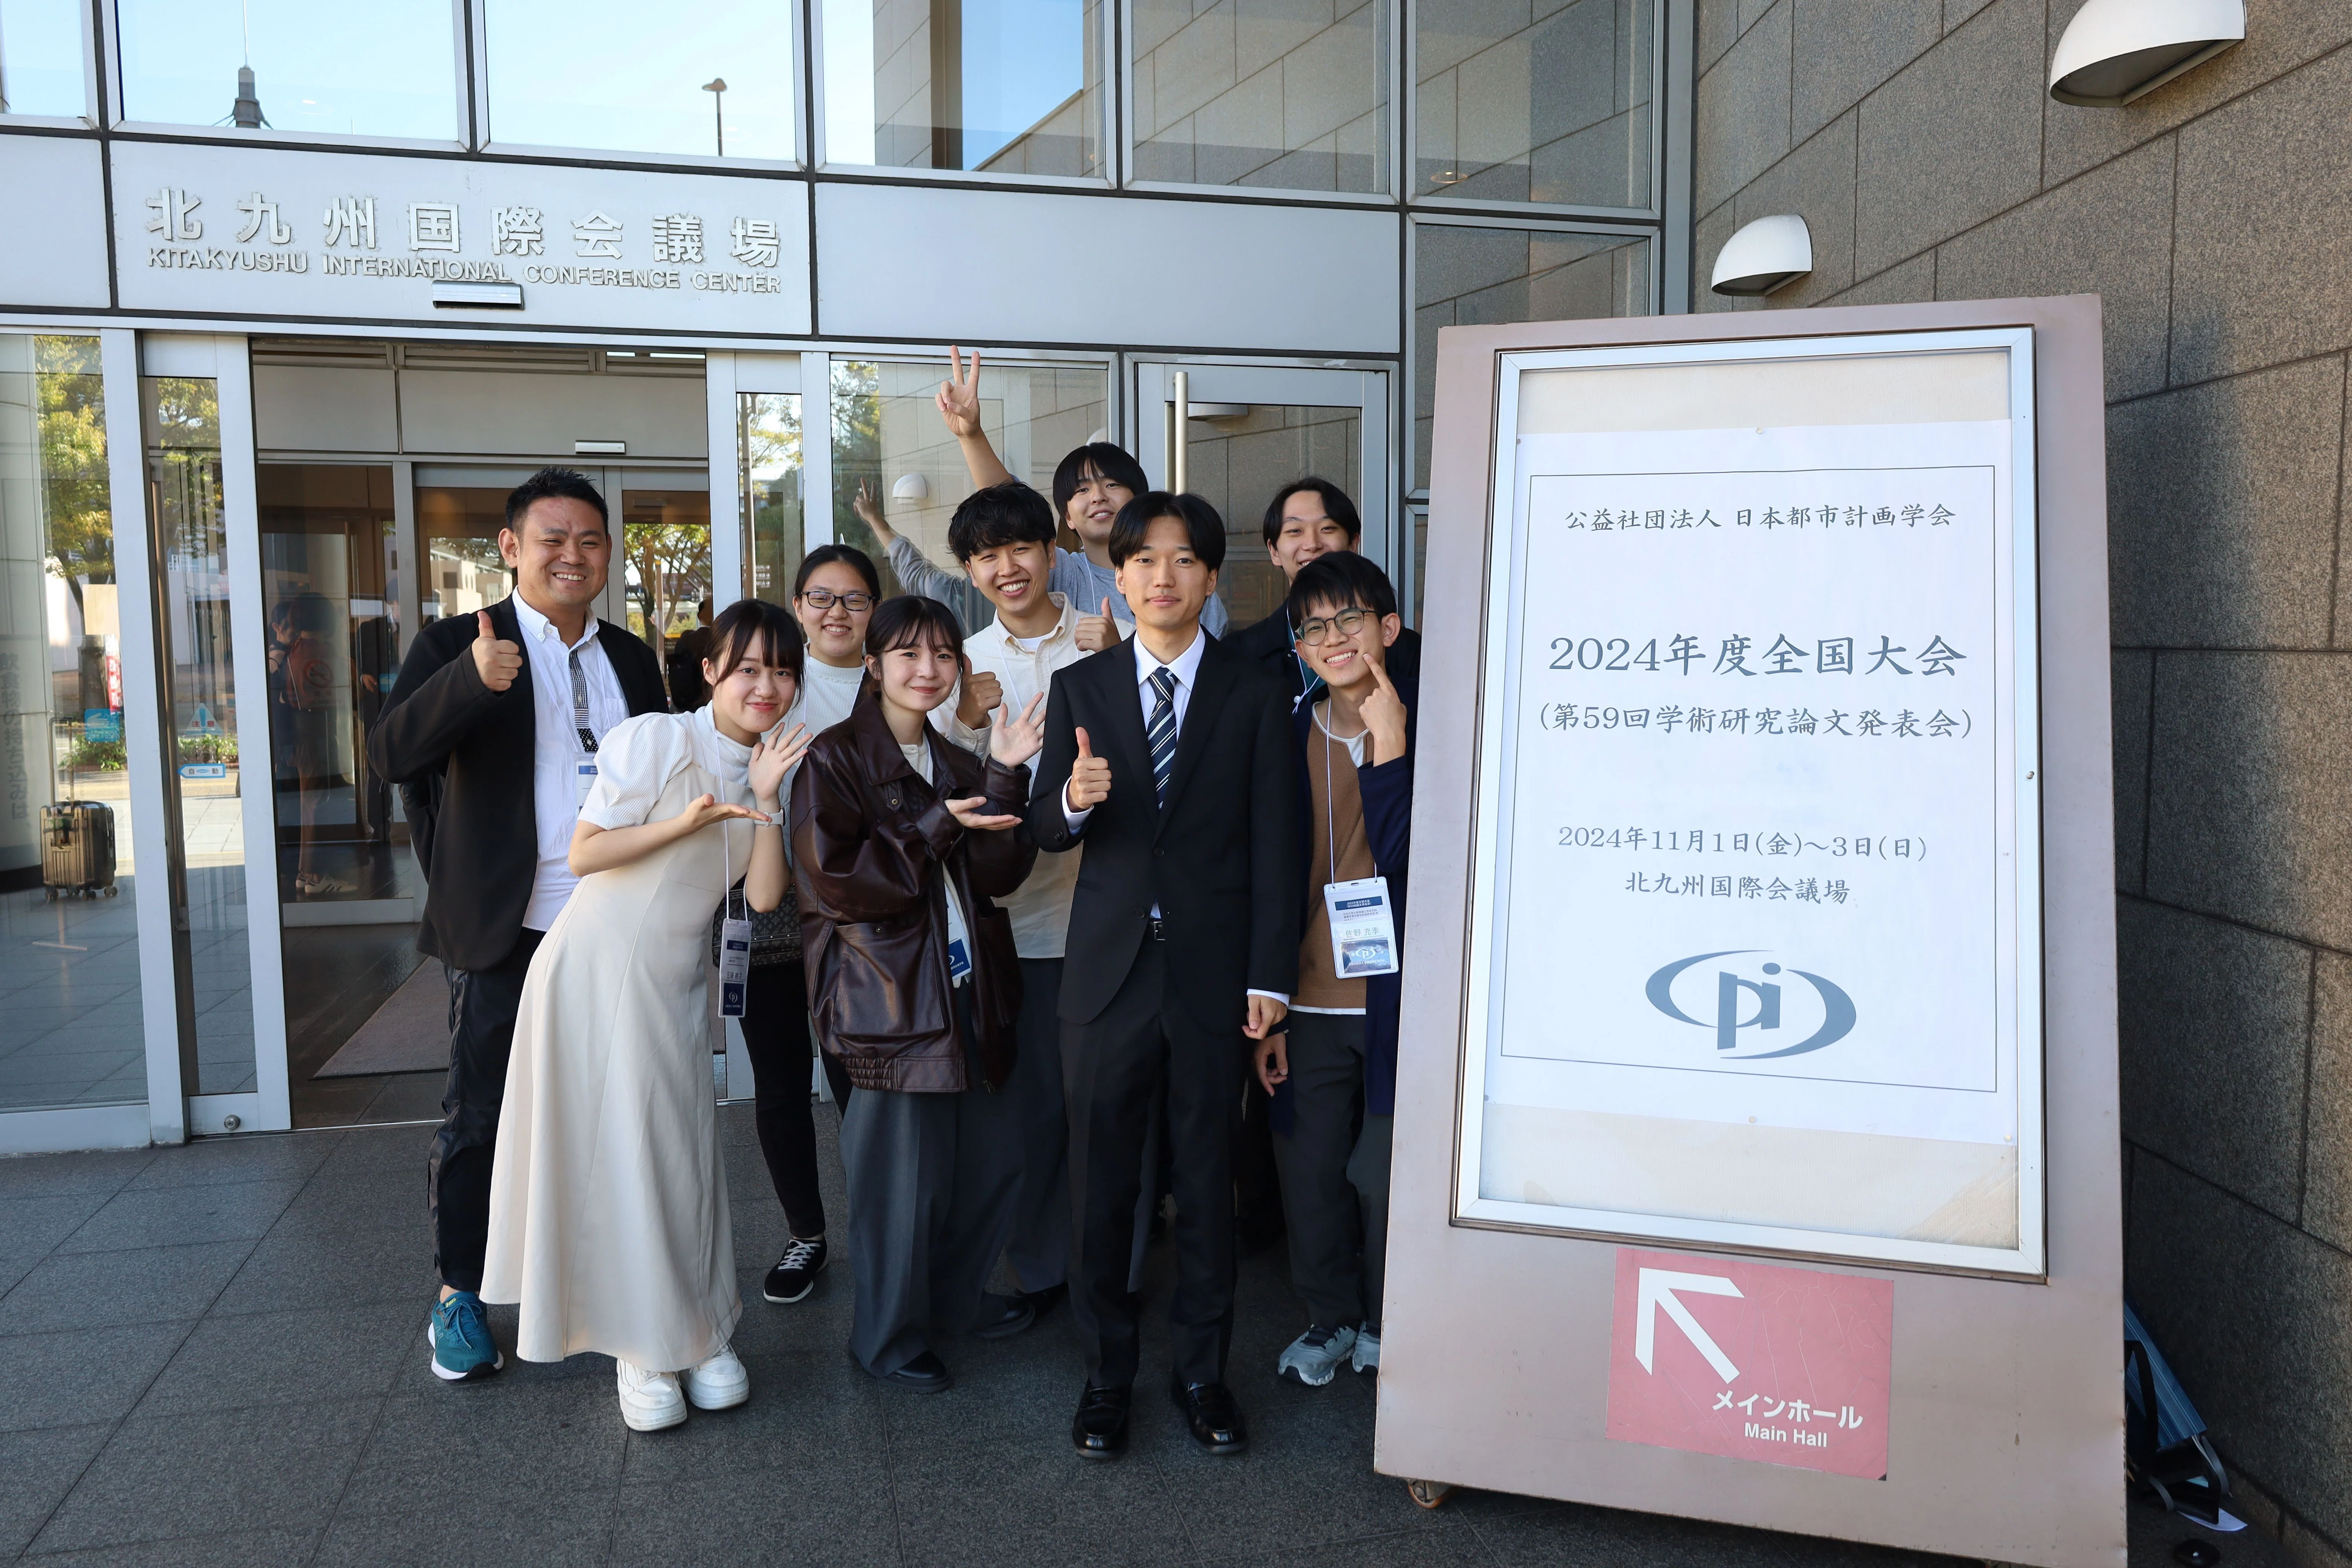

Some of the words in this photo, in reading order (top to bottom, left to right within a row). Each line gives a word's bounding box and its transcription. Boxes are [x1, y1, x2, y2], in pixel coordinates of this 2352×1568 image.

[147, 188, 781, 268] 北九州国際会議場
[148, 247, 308, 274] KITAKYUSHU
[323, 254, 512, 283] INTERNATIONAL
[524, 264, 680, 289] CONFERENCE
[691, 271, 781, 294] CENTER
[1565, 508, 1723, 531] 公益社団法人
[1736, 503, 1956, 528] 日本都市計画学会
[1549, 632, 1967, 677] 2024年度全国大会
[1540, 702, 1972, 739] (第59回学術研究論文発表会)
[1625, 871, 1850, 905] 北九州国際会議場
[1712, 1389, 1864, 1429] メインホール
[1744, 1423, 1787, 1442] Main
[1793, 1429, 1827, 1447] Hall
